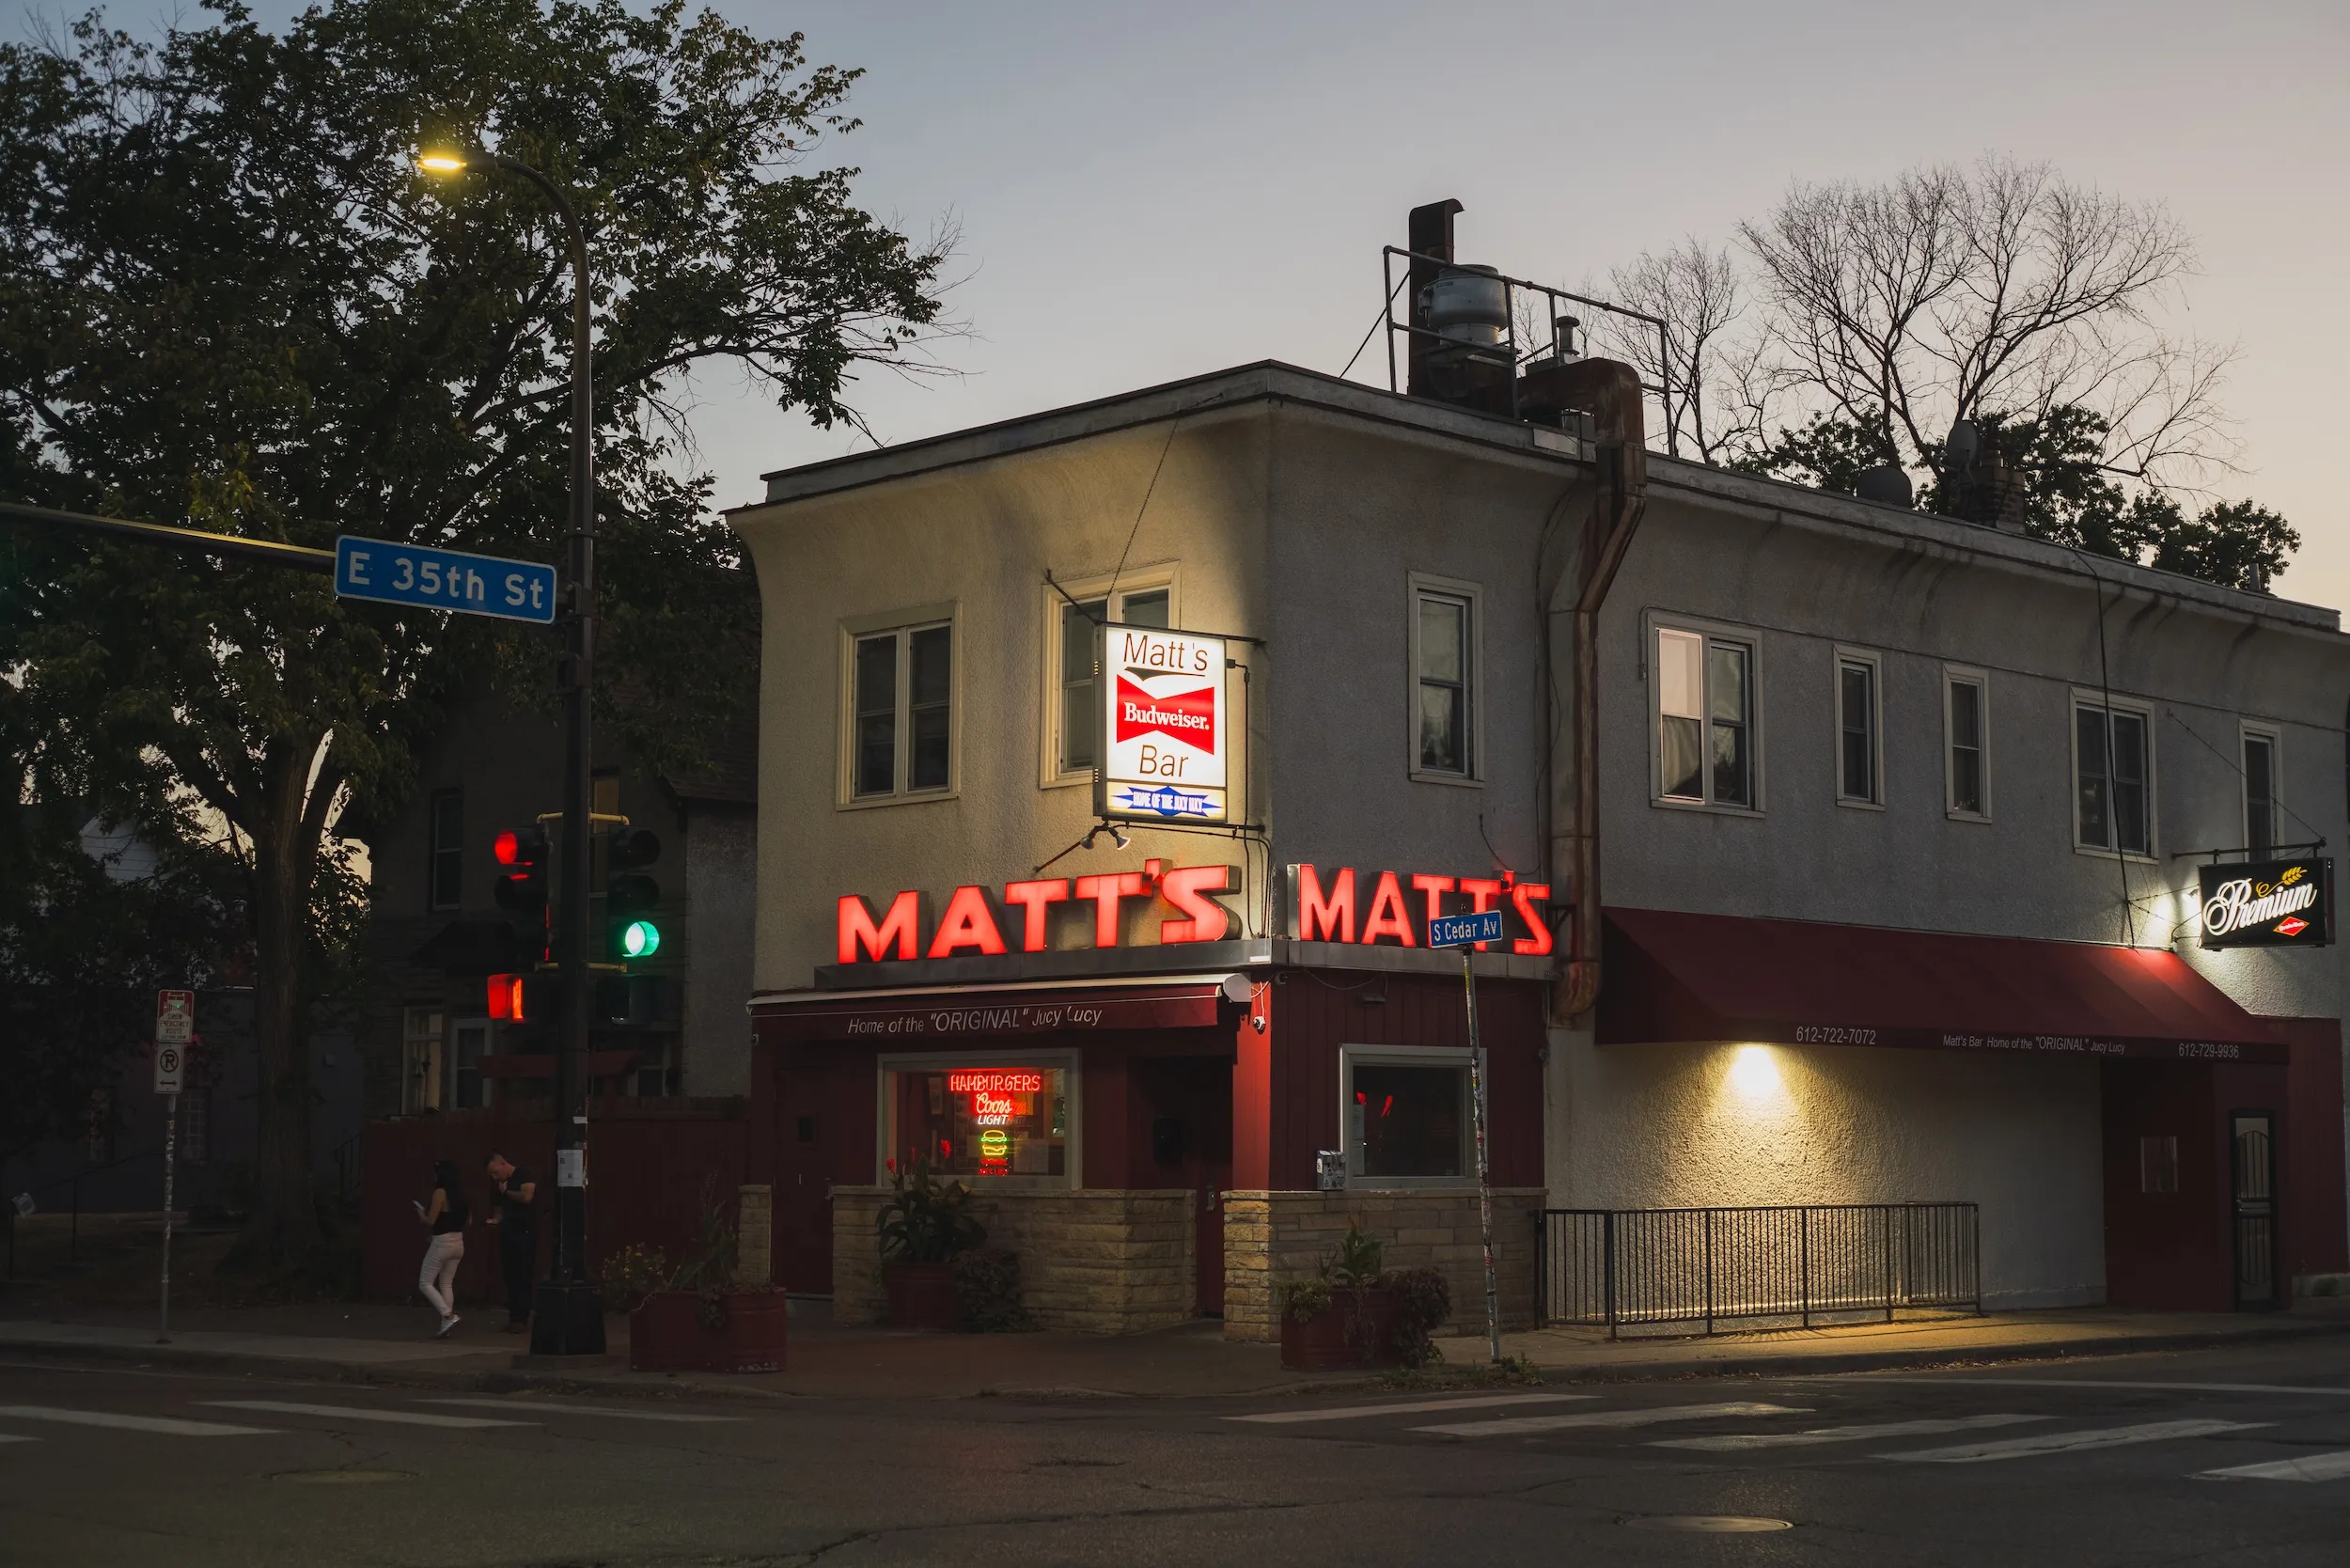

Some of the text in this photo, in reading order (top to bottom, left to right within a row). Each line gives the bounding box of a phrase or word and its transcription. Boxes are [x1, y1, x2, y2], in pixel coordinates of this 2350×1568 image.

[349, 551, 543, 609] E 35th St
[1123, 633, 1208, 671] Matt's
[1139, 745, 1189, 777] Bar
[838, 857, 1235, 964] MATT'S
[1299, 864, 1553, 956] MATT'S
[2202, 878, 2317, 936] Premium
[1434, 917, 1497, 942] S Cedar Av
[848, 1019, 884, 1033] Home
[888, 1018, 904, 1033] of
[905, 1016, 924, 1032] the
[930, 1008, 1028, 1032] "ORIGINAL"
[1032, 1009, 1062, 1028] Jucy
[1796, 1027, 1876, 1044] 612-722-7072
[1943, 1035, 2125, 1055] Matt's Bar Home of the "ORIGINAL" Jucy Lucy
[2179, 1043, 2239, 1058] 612-729-9936
[950, 1074, 1041, 1091] HAMBURGERS
[976, 1092, 1012, 1114] Coors
[978, 1114, 1009, 1125] LIGHT
